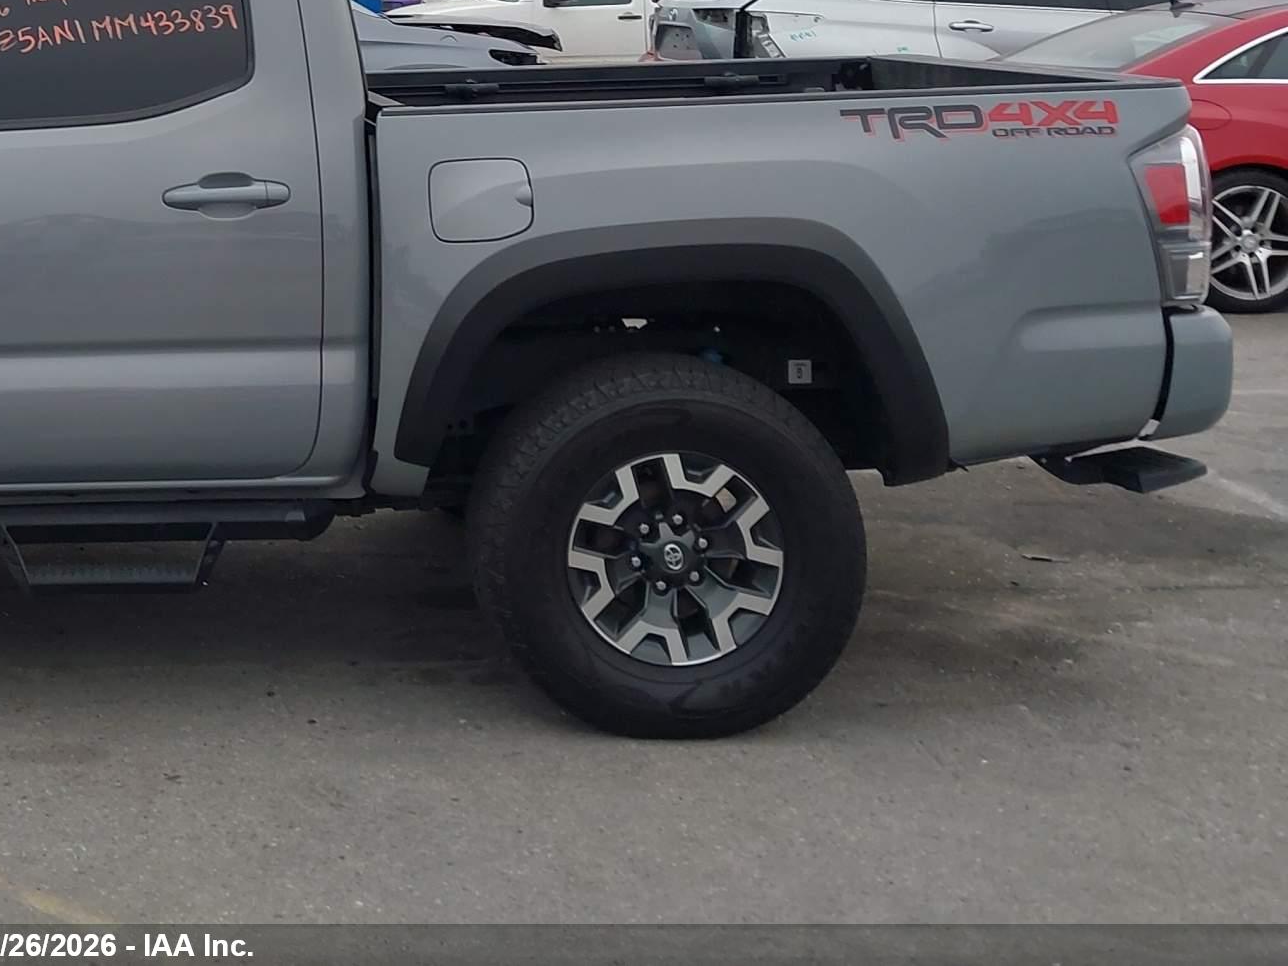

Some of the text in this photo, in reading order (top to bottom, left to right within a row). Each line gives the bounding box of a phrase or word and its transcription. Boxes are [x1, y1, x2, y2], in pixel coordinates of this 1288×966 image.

[840, 104, 987, 141] TRD
[992, 126, 1117, 138] OFF ROAD
